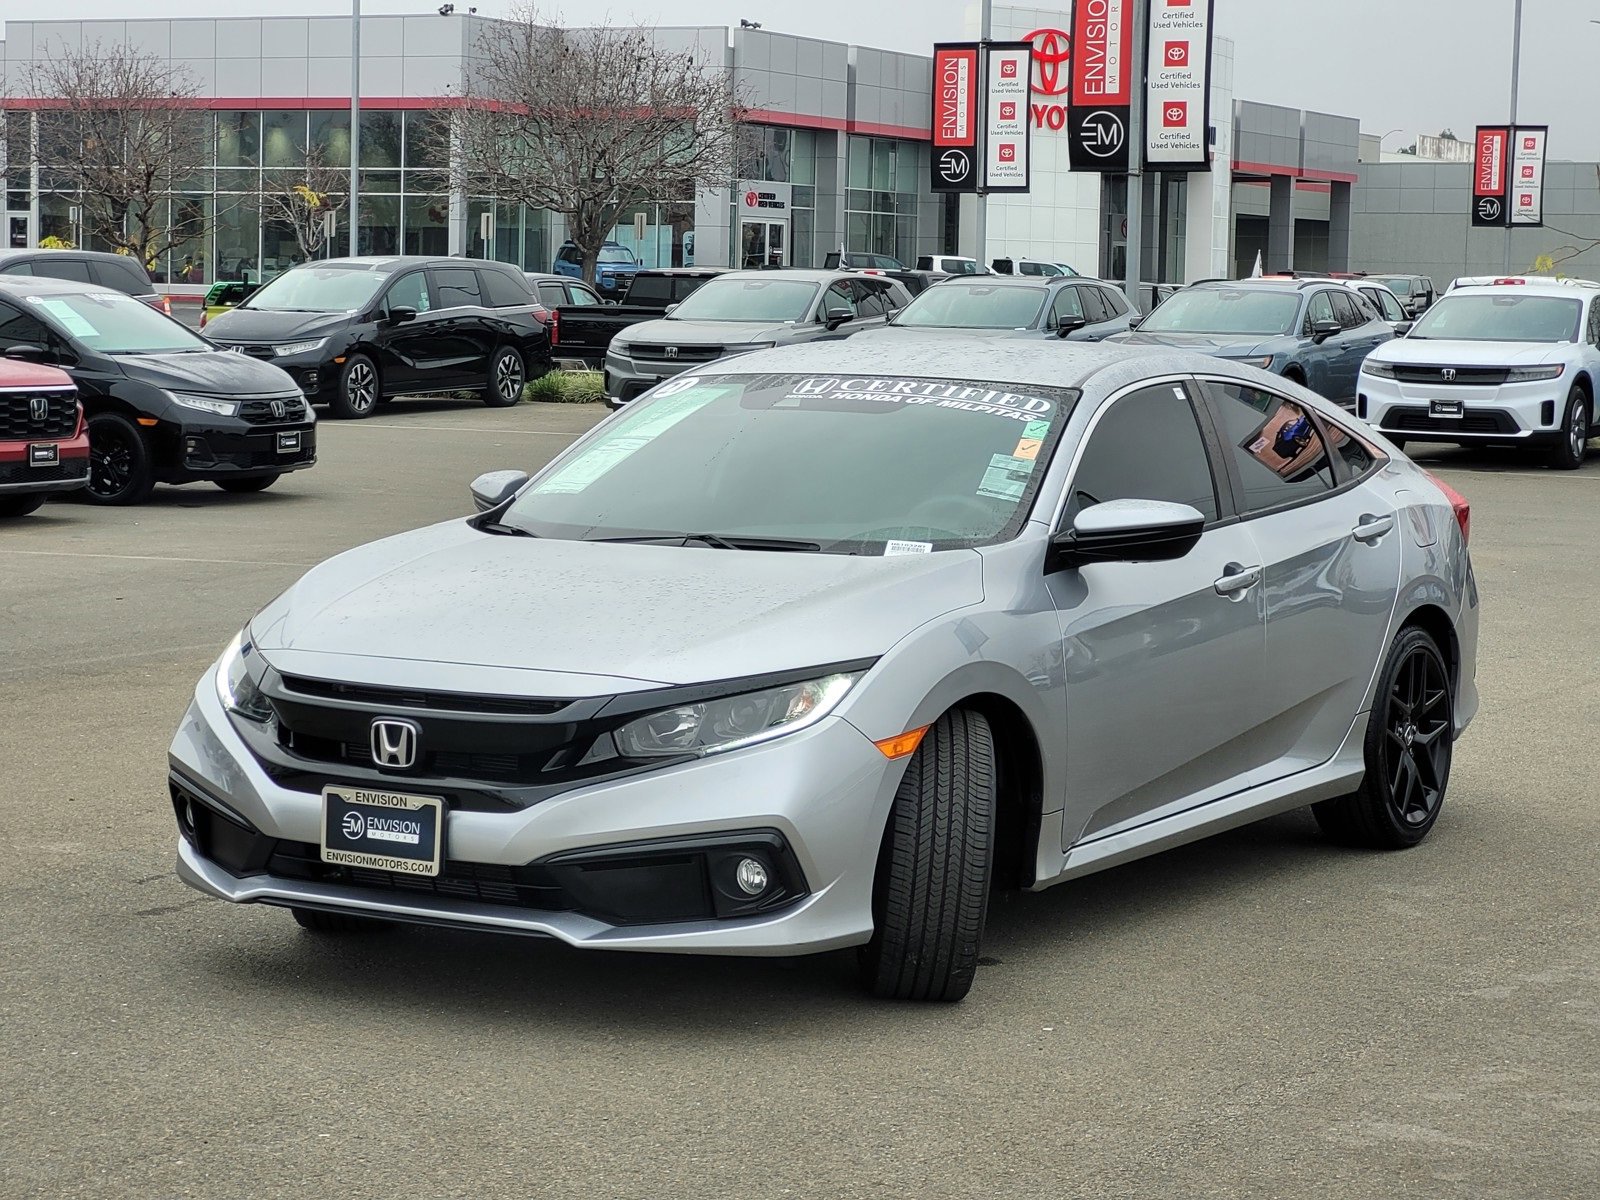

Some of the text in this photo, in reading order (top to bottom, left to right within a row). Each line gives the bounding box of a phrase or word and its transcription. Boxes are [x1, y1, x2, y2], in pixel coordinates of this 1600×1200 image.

[1084, 0, 1106, 94] ENVISIO
[1108, 6, 1118, 84] MOTOR
[942, 58, 958, 138] ENVISION
[1030, 104, 1068, 130] YO
[1480, 135, 1493, 190] ENVISION
[829, 393, 1037, 422] HONDA OF MILPITAS
[840, 379, 1051, 412] CERTIFIED
[355, 792, 407, 807] ENVISION
[367, 817, 420, 834] ENVISION
[372, 832, 414, 841] MOTORS
[326, 852, 433, 874] ENVISIONMOTORS.COM
